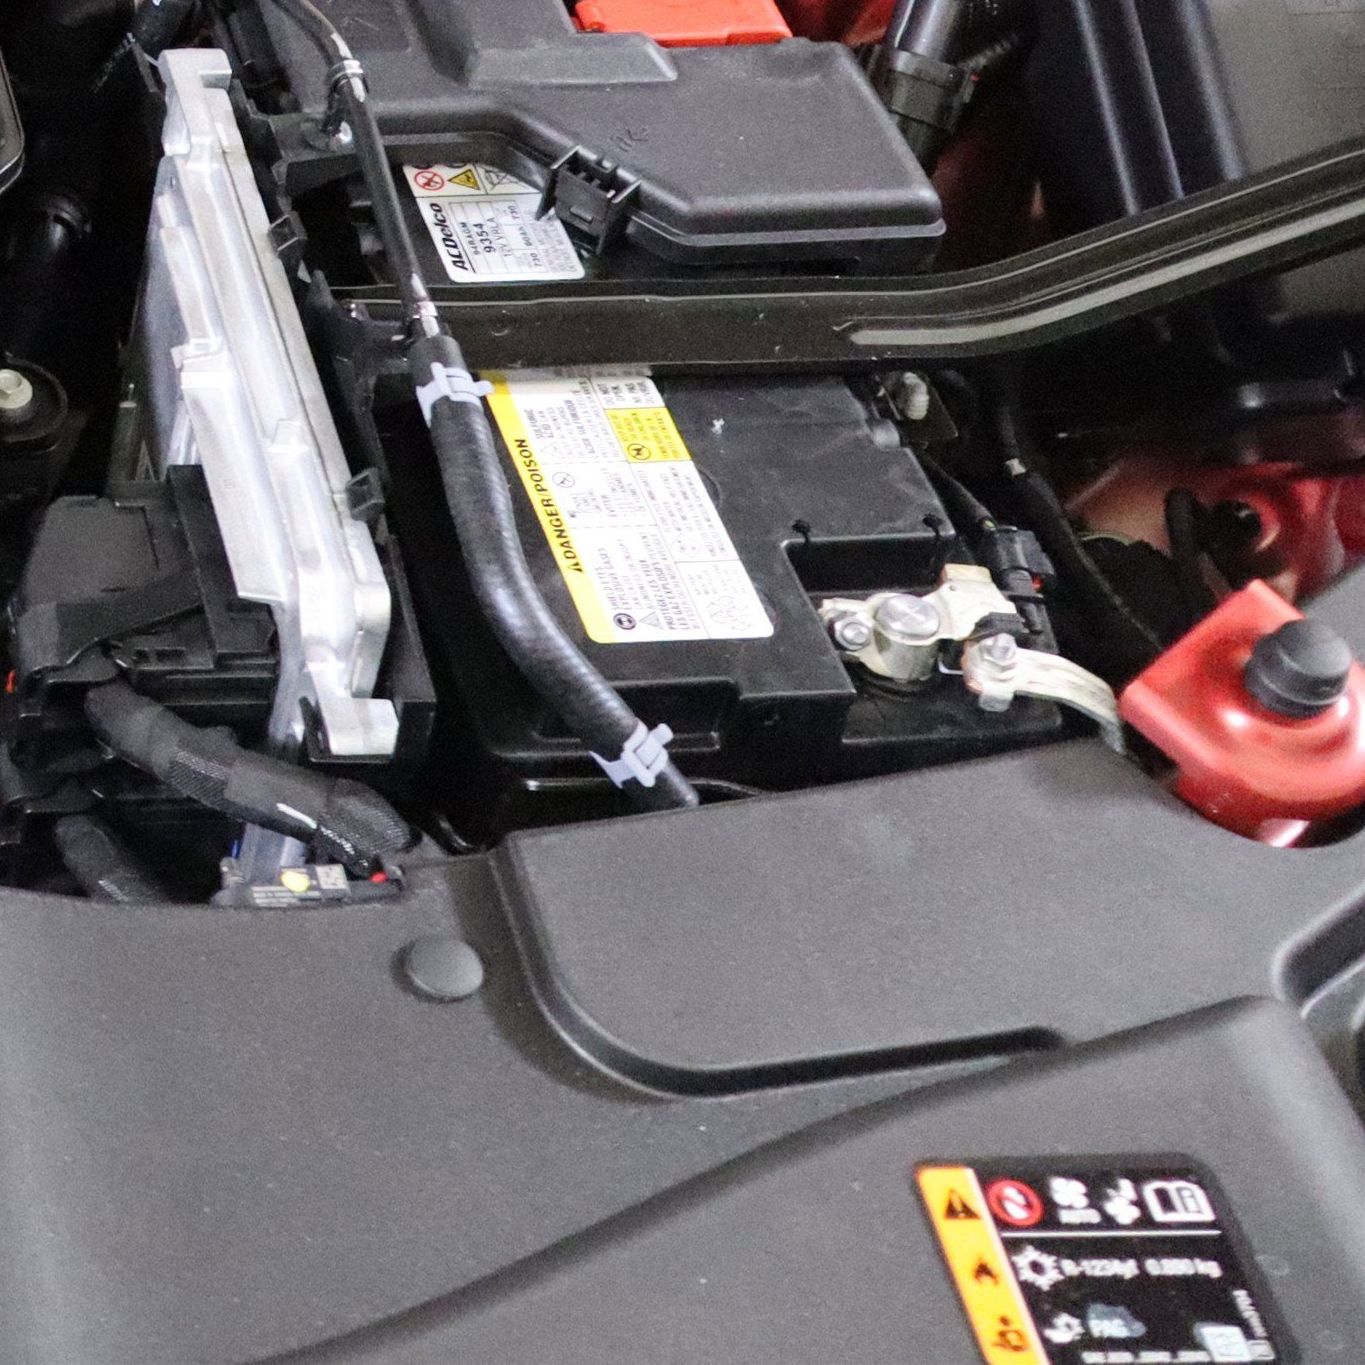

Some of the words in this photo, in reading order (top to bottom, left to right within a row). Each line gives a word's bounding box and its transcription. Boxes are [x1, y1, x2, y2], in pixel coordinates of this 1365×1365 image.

[429, 202, 468, 270] ACDelco
[471, 222, 496, 252] 9354
[513, 438, 577, 559] DANGER/POISON
